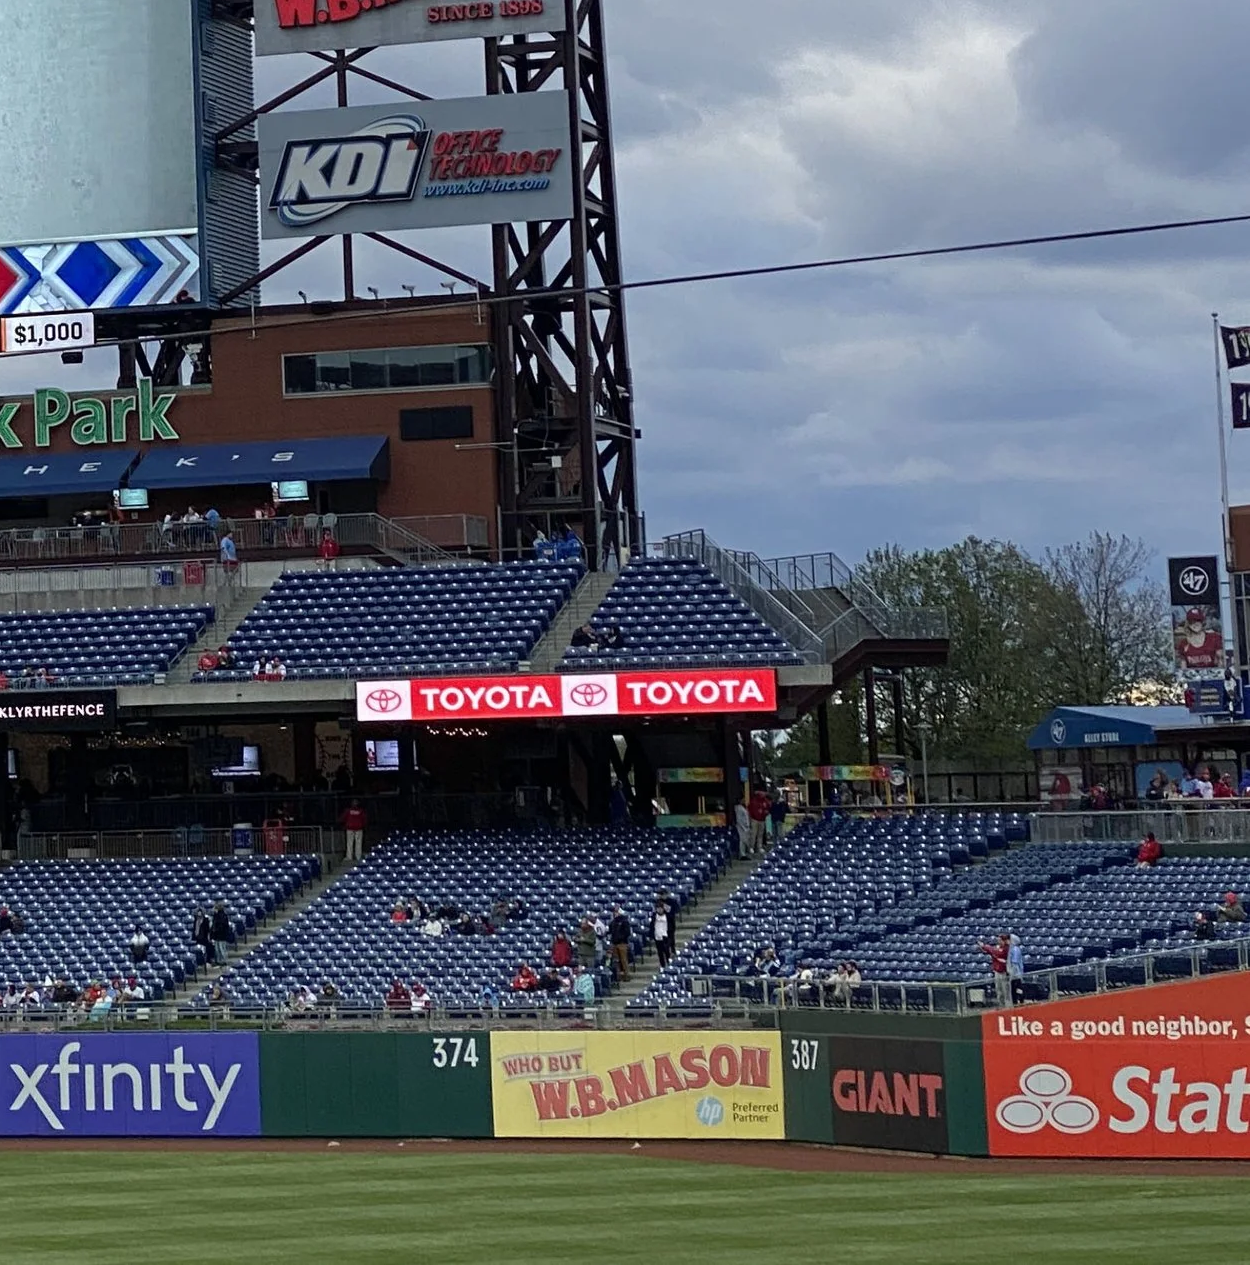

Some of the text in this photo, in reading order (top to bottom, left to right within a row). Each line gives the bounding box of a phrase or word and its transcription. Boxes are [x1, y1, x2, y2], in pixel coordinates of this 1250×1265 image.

[427, 0, 493, 23] SINCE
[433, 128, 504, 156] OFFICE
[429, 148, 562, 181] TECHNOLOGY
[424, 177, 551, 198] www.kdi-inc.com
[14, 321, 83, 346] $1,000
[33, 377, 178, 448] Park
[420, 679, 764, 712] TOYOTA TOYOTA
[998, 1016, 1043, 1035] Like
[1050, 1021, 1063, 1035] a
[1070, 1016, 1125, 1040] good
[1132, 1016, 1238, 1040] neighbor,
[433, 1038, 479, 1067] 374
[502, 1053, 582, 1076] WHO BUT
[791, 1039, 819, 1070] 387
[9, 1041, 242, 1130] xfinity
[832, 1069, 943, 1118] GIANT
[1108, 1065, 1250, 1134] Stat
[699, 1096, 722, 1126] hp
[732, 1102, 779, 1112] Preferred
[733, 1113, 770, 1123] Partner
